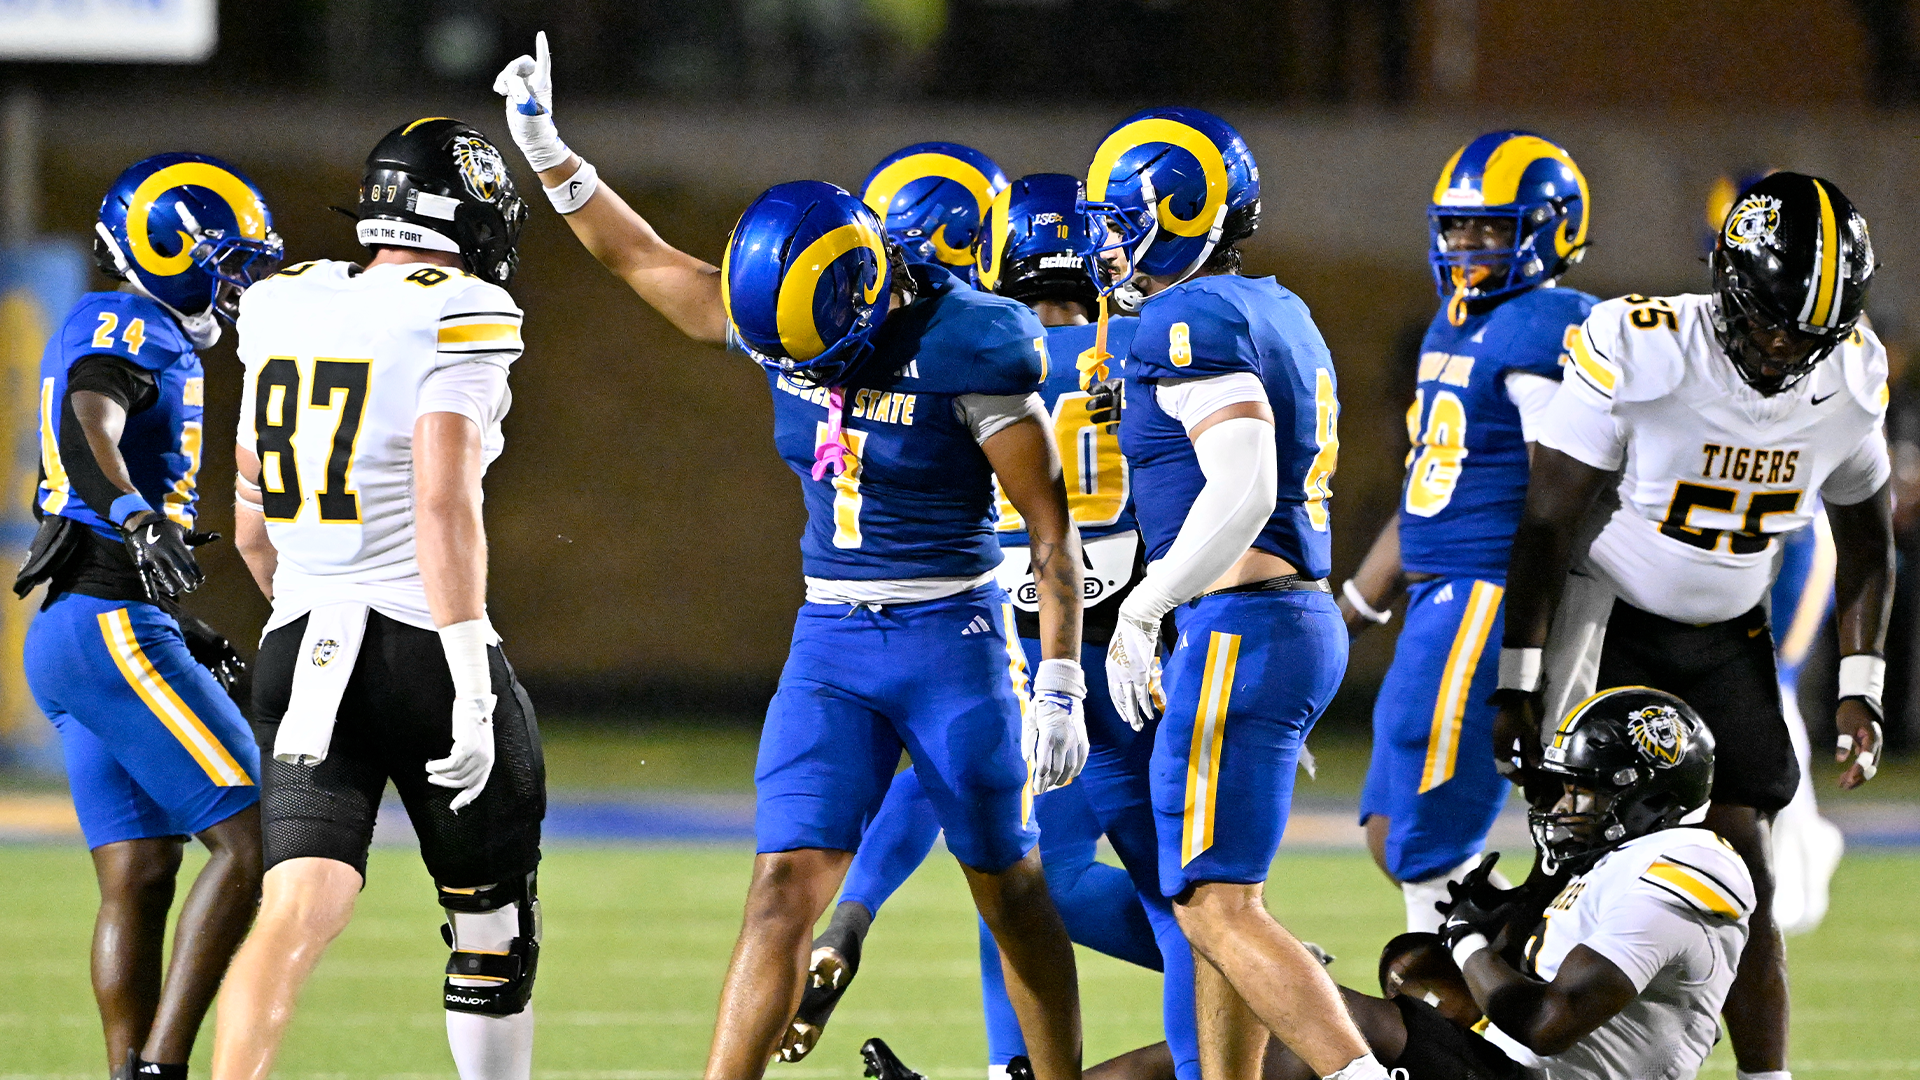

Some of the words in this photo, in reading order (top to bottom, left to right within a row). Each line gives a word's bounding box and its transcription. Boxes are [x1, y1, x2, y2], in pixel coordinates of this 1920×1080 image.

[371, 184, 397, 203] 87
[381, 228, 395, 239] THE
[399, 230, 423, 243] FORT
[1056, 224, 1069, 239] 10
[91, 311, 147, 355] 24
[1169, 321, 1192, 368] 8
[852, 387, 917, 426] STATE
[255, 355, 374, 524] 87
[1702, 443, 1799, 484] TIGERS
[815, 420, 869, 549] 7
[1656, 480, 1803, 554] 55
[1117, 631, 1131, 669] adidas
[445, 994, 489, 1005] DONJOY
